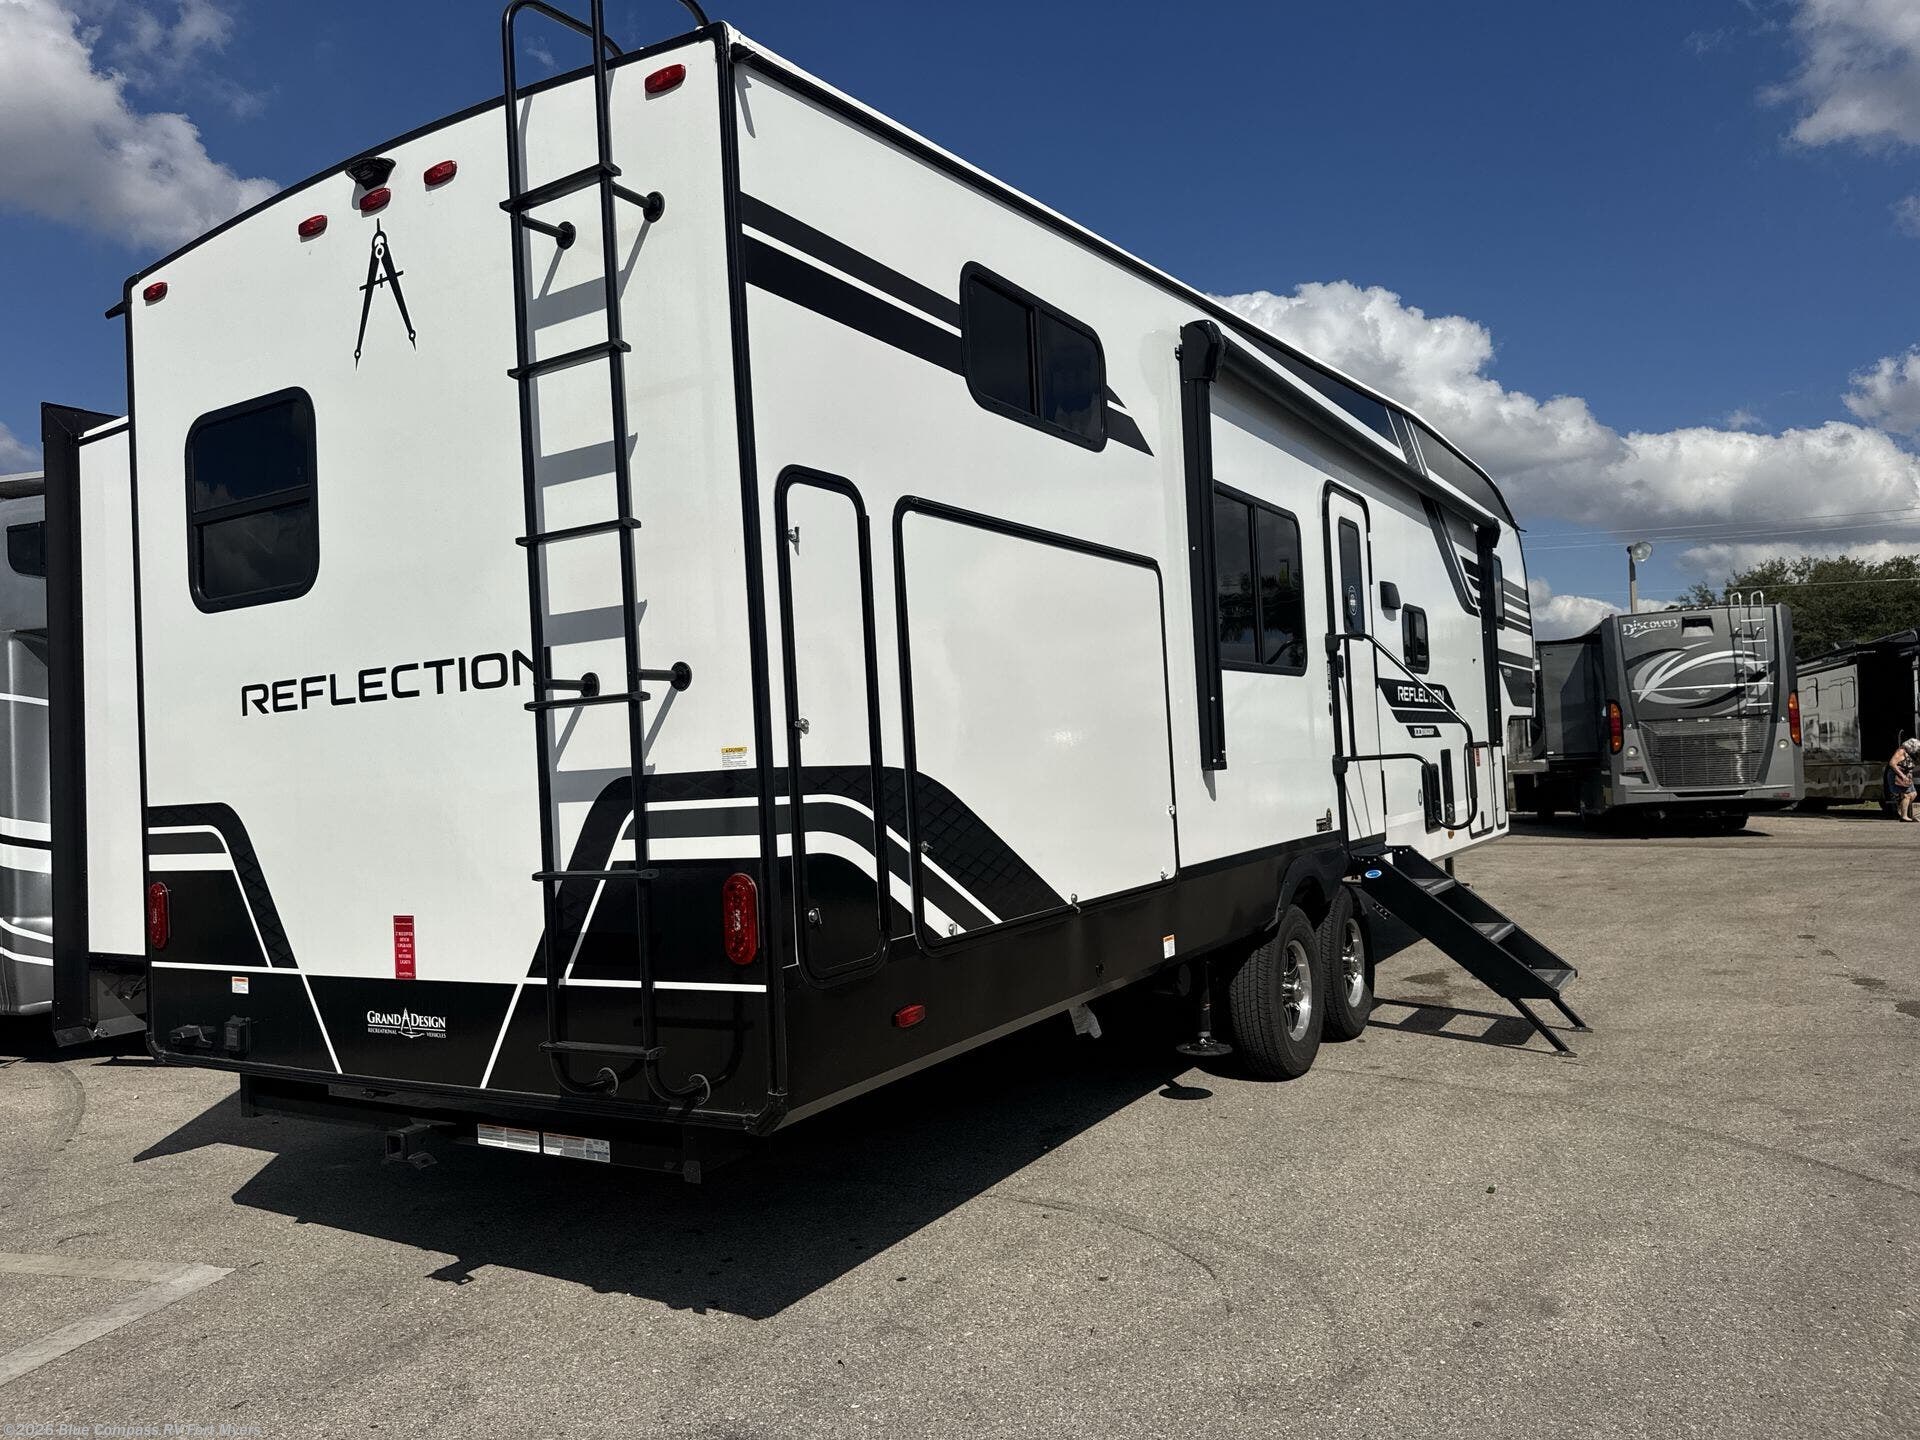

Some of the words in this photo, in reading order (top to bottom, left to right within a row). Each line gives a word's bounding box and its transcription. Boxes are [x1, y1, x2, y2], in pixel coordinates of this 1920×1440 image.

[1622, 620, 1679, 636] Discovery
[241, 648, 551, 717] REFLECTION
[367, 1010, 401, 1025] GRAND
[410, 1013, 446, 1028] DESIGN
